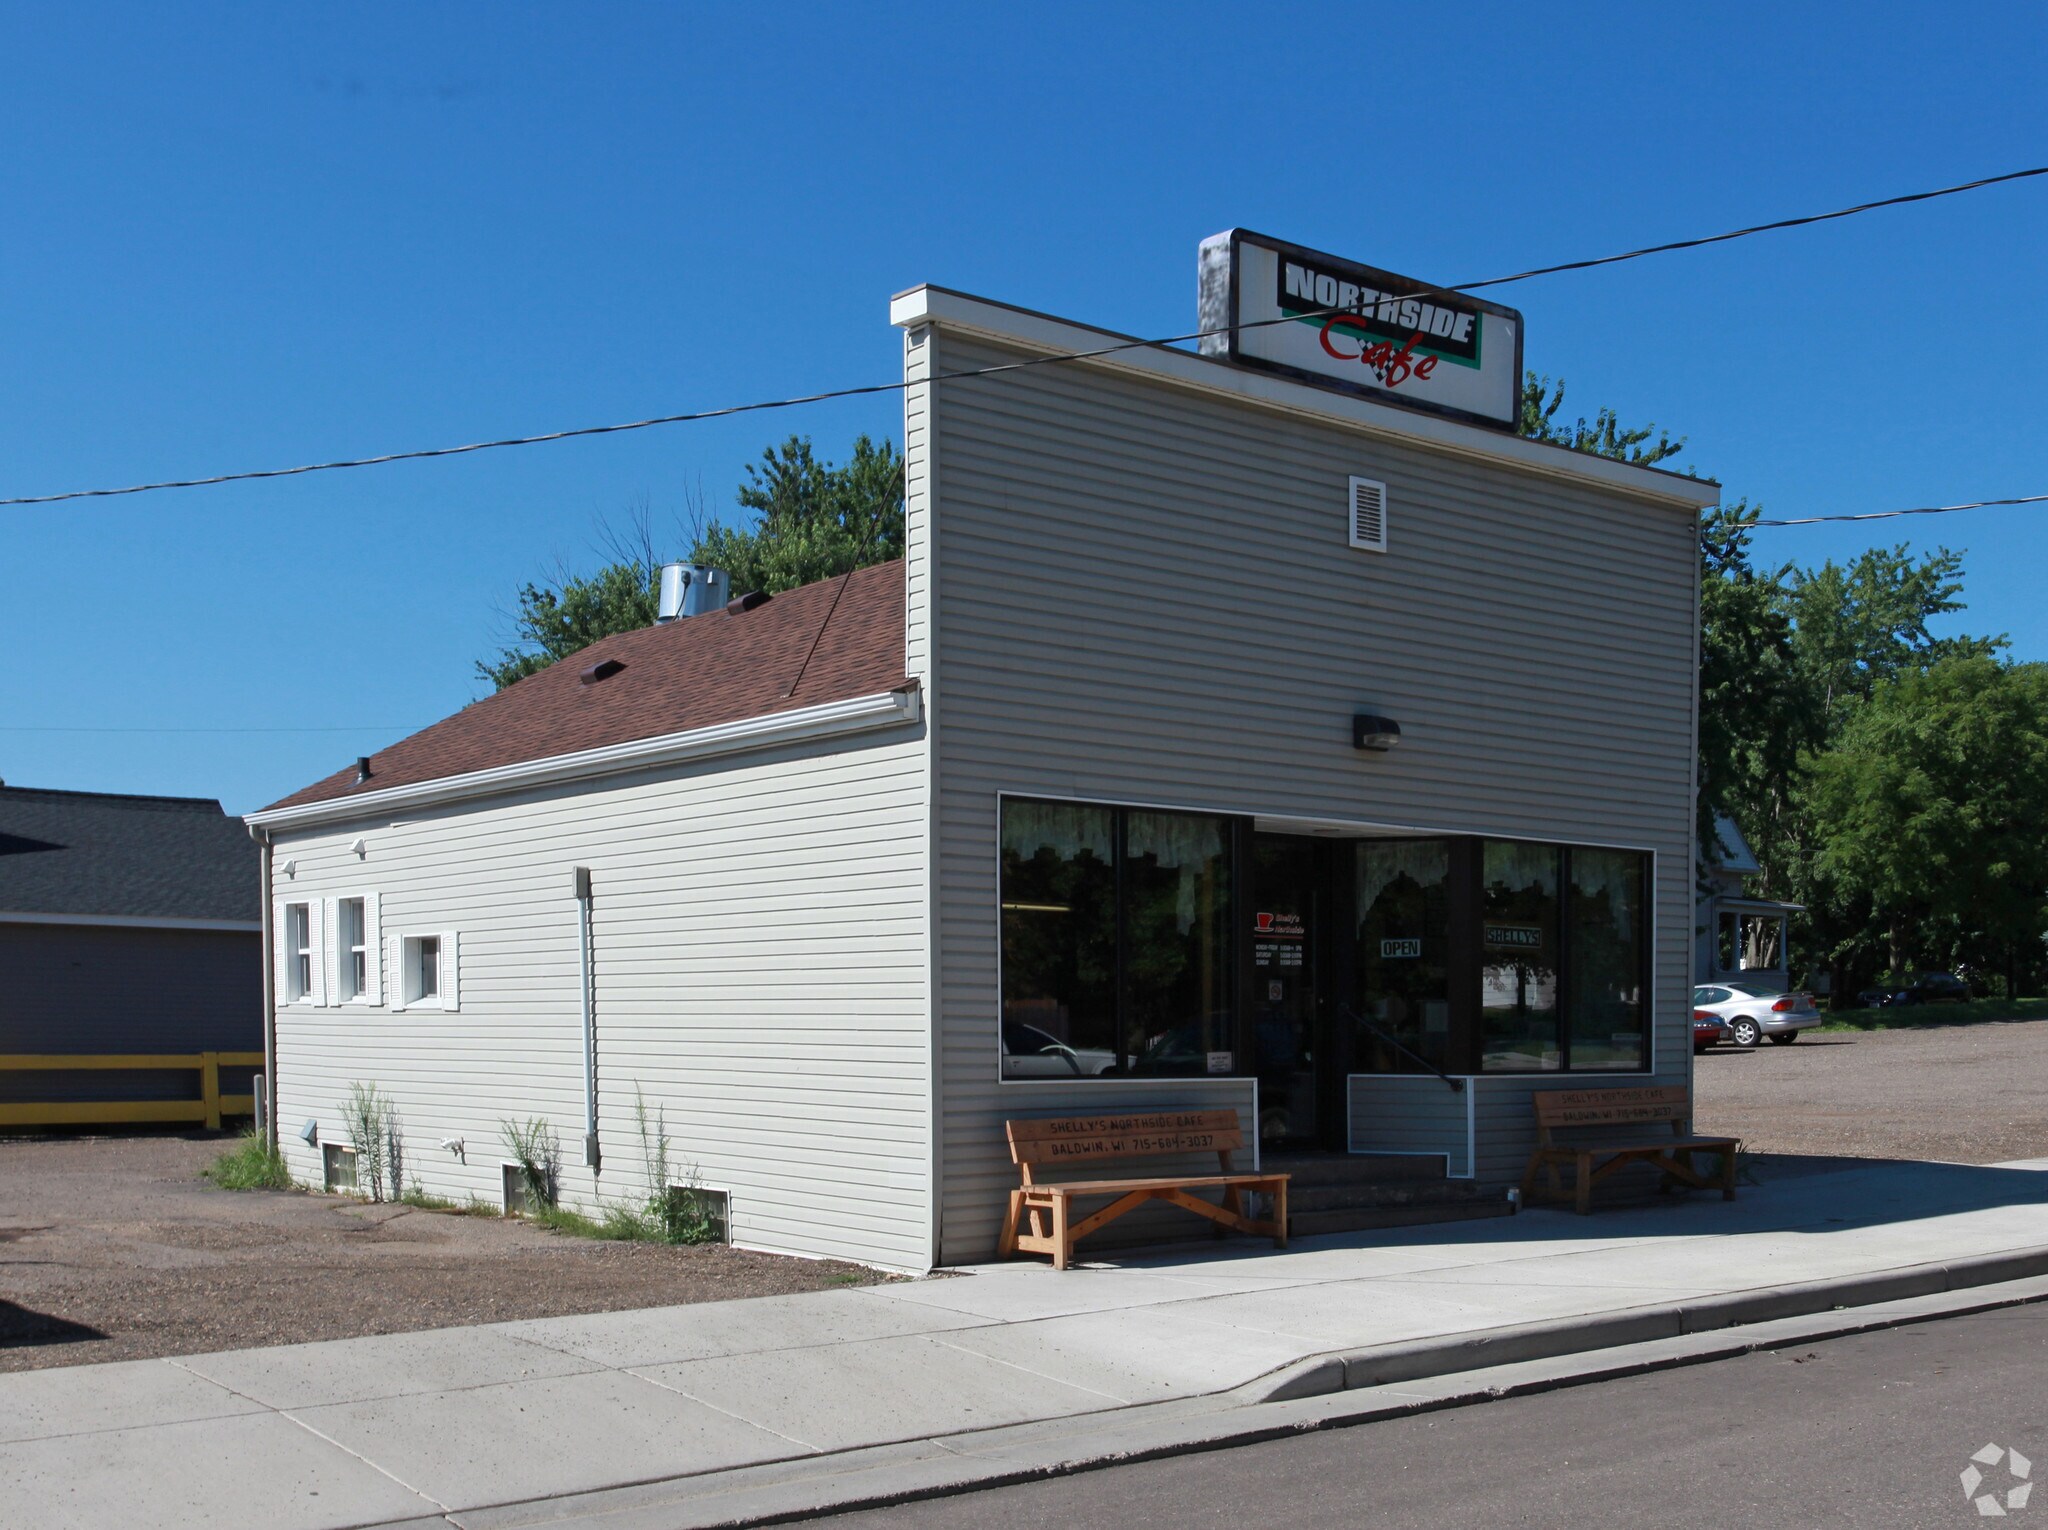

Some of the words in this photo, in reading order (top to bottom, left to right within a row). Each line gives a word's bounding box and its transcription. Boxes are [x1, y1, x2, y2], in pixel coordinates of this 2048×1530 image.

[1286, 261, 1476, 343] NORTHSIDE
[1319, 314, 1439, 388] Cafe
[1383, 940, 1419, 956] OPEN
[1050, 1119, 1106, 1134] SHELLY'S
[1110, 1116, 1174, 1130] NORTHSIDE
[1177, 1115, 1204, 1127] CAFE
[1112, 1139, 1125, 1151] WI
